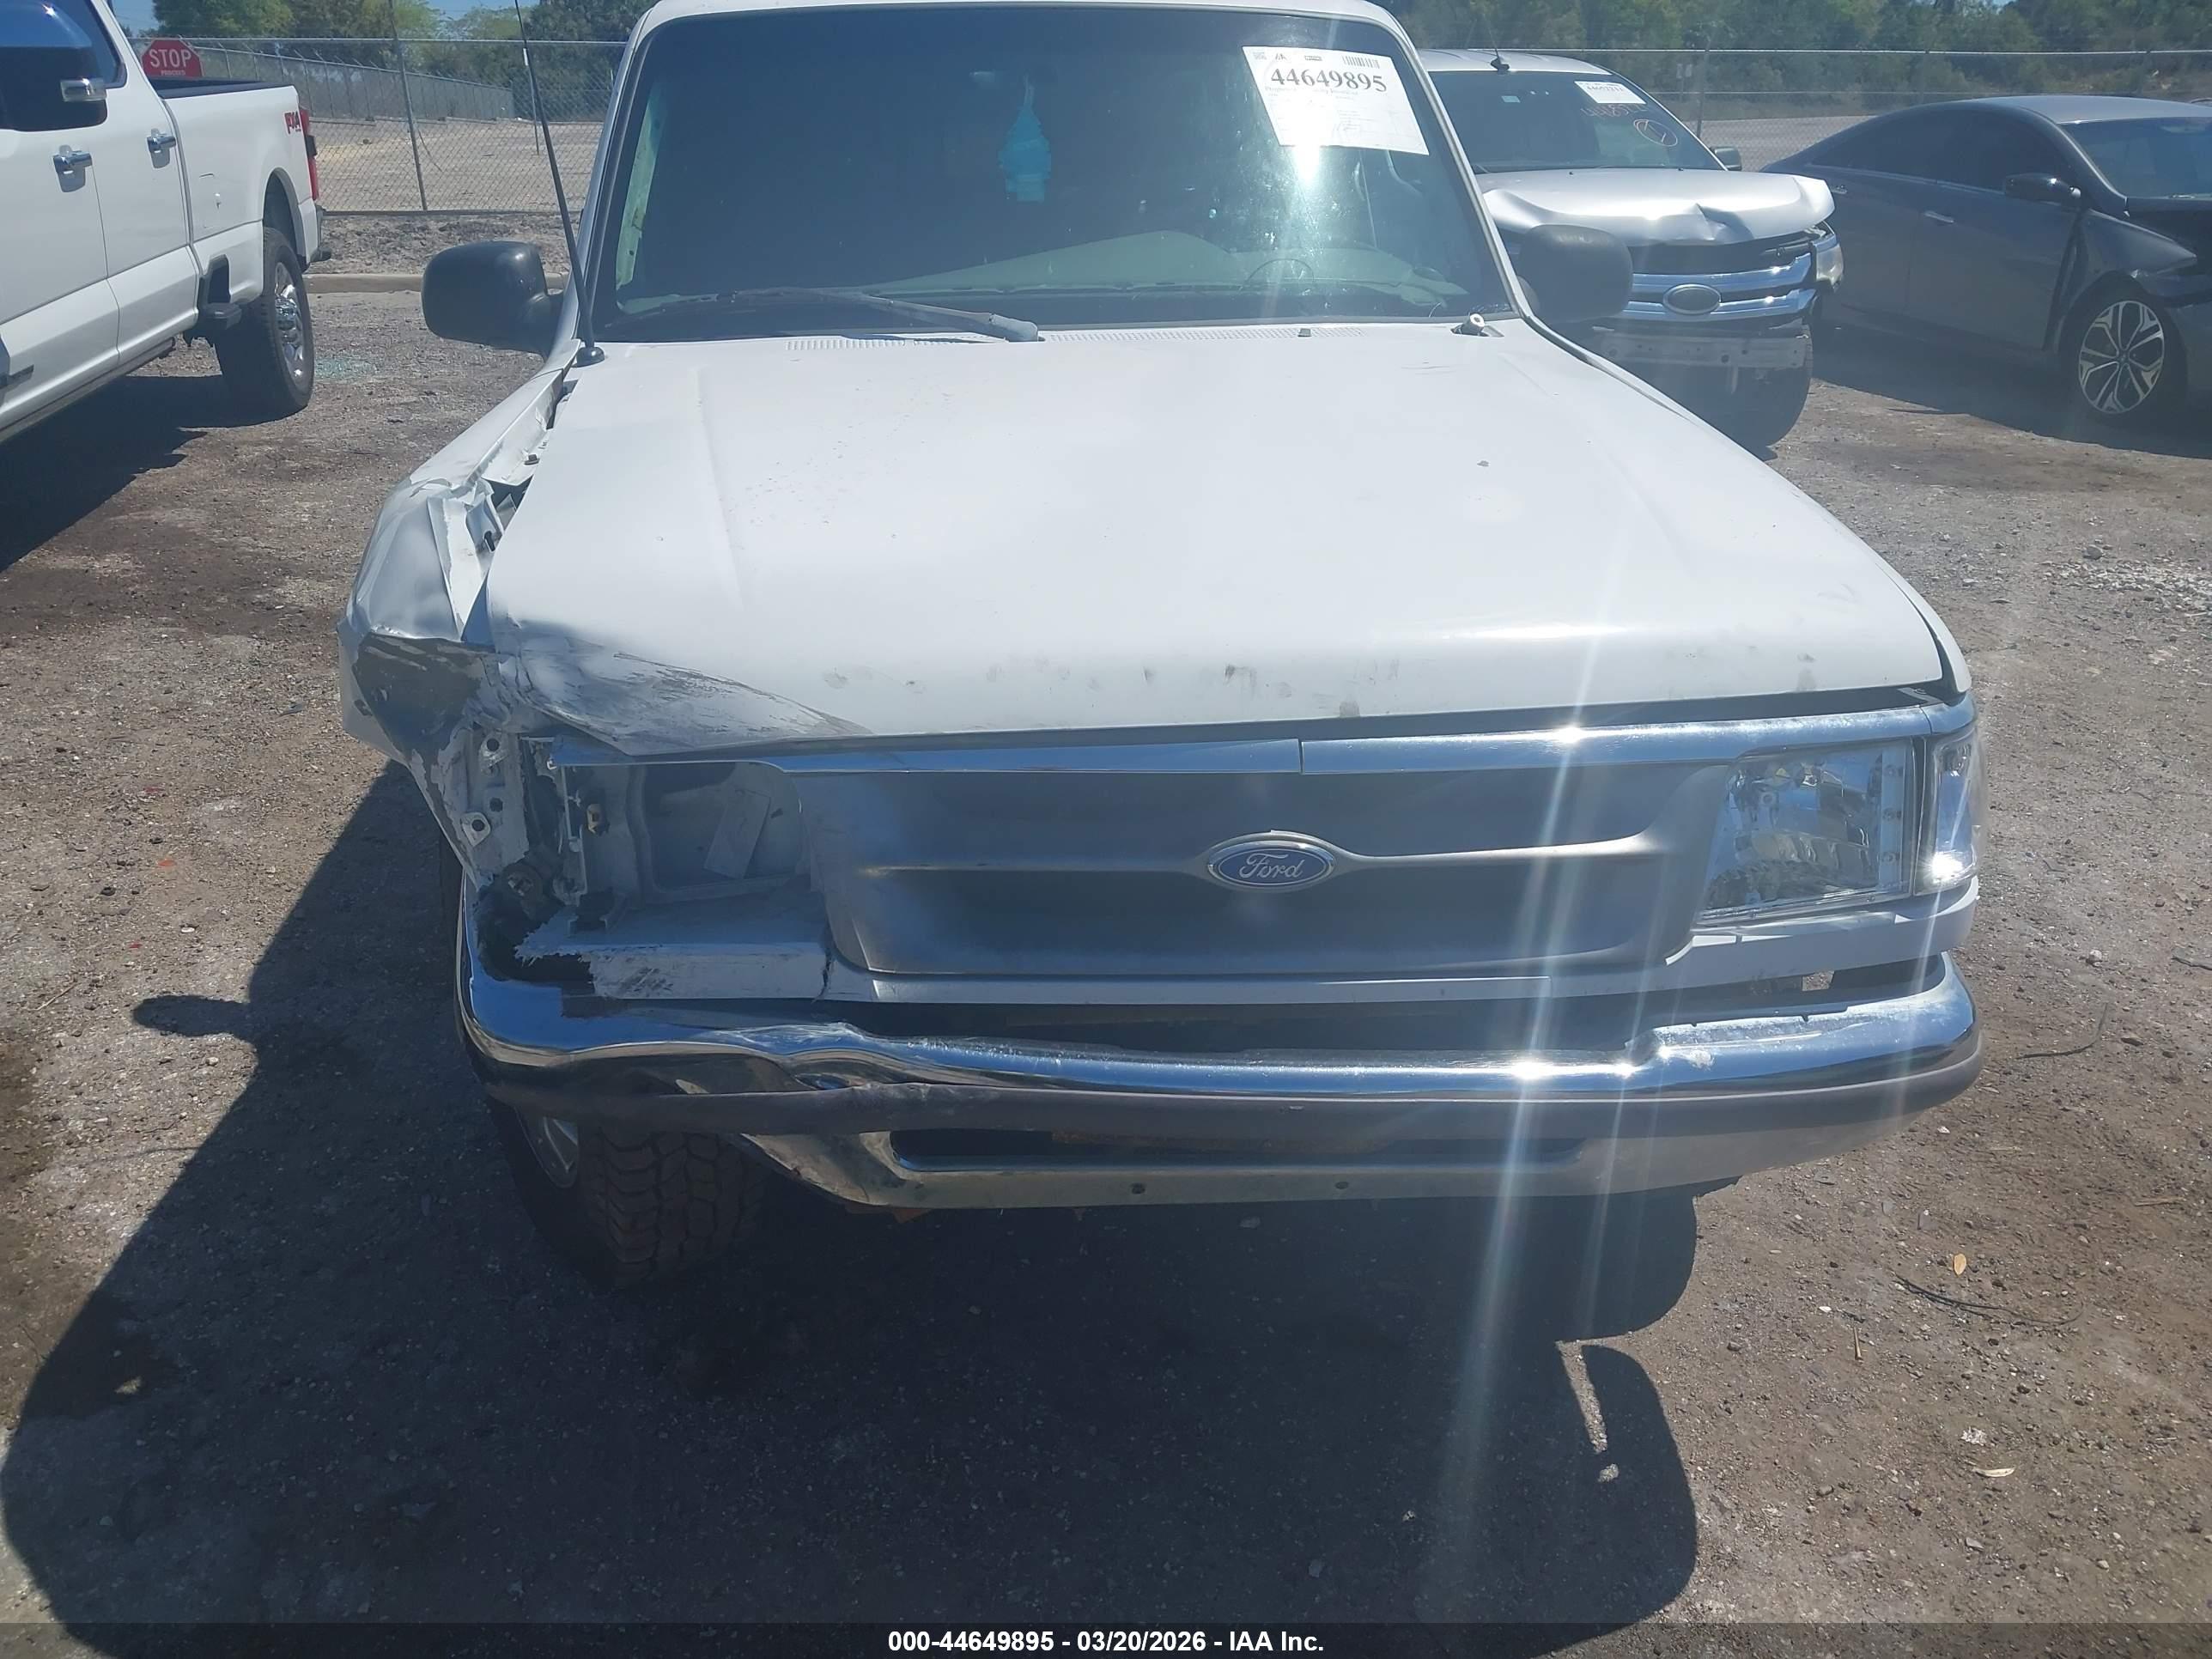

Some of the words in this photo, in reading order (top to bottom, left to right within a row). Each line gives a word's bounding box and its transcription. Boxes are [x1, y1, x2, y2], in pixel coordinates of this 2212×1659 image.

[149, 48, 192, 68] STOP
[1271, 68, 1388, 93] 44649895
[1239, 853, 1305, 878] Ford
